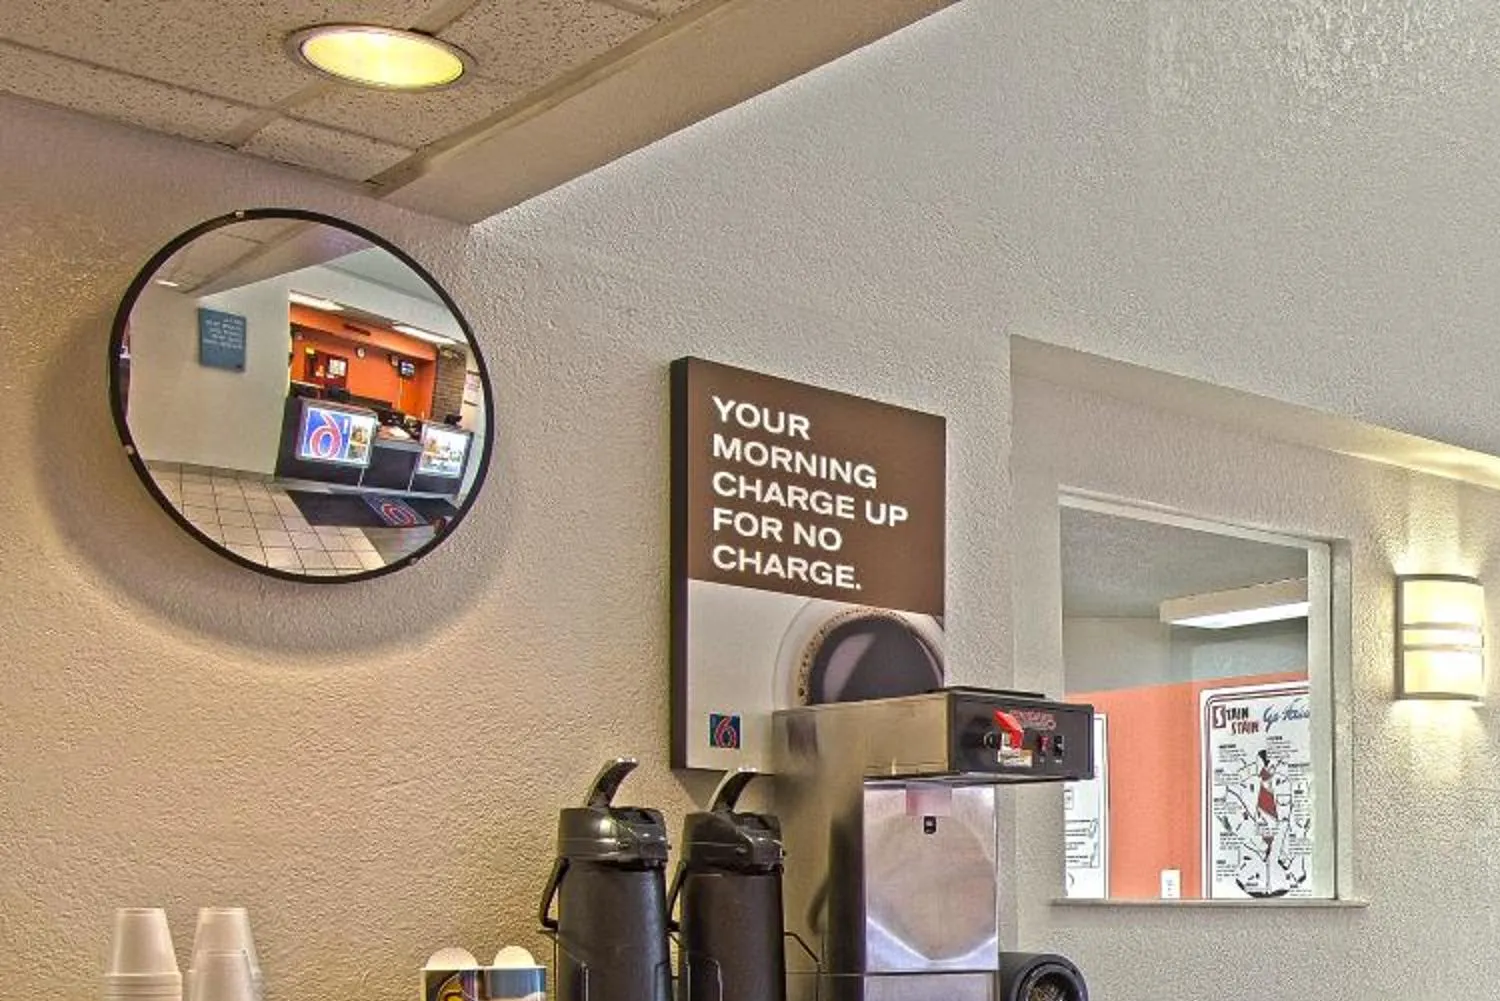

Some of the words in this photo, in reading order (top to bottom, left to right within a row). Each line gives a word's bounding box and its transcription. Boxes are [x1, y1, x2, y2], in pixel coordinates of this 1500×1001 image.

[712, 395, 811, 441] YOUR
[712, 433, 878, 489] MORNING
[712, 471, 856, 519] CHARGE
[865, 500, 909, 527] UP
[712, 507, 784, 542] FOR
[793, 521, 843, 551] NO
[712, 544, 862, 591] CHARGE.
